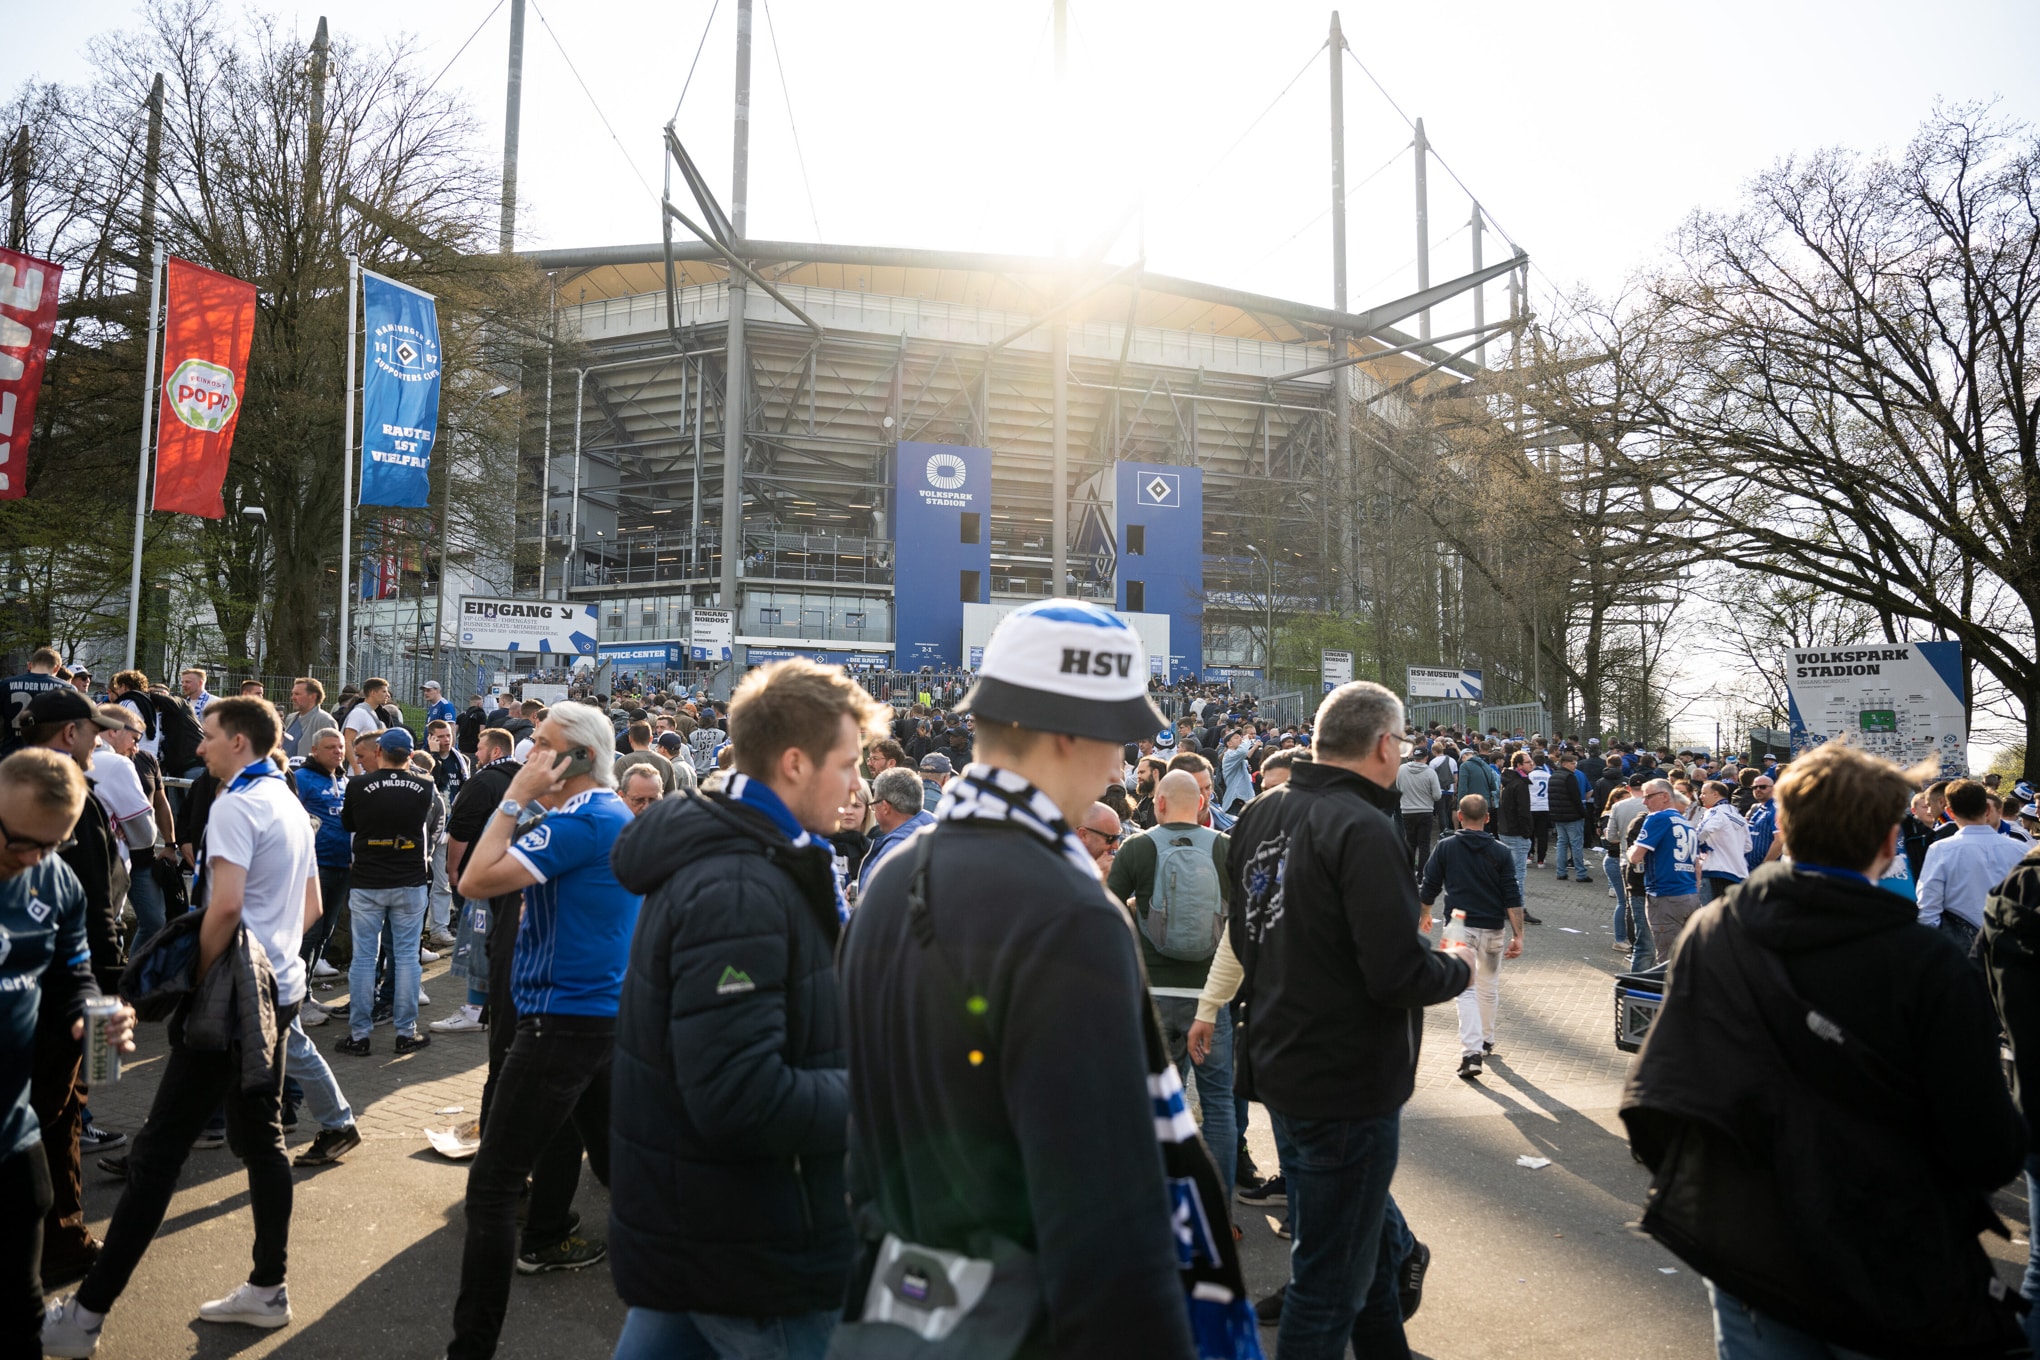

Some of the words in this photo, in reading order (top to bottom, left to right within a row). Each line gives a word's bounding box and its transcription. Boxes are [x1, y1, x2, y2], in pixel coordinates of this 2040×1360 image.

[375, 342, 388, 353] 18
[425, 354, 438, 364] 87
[190, 375, 226, 389] FEINKOST
[178, 384, 230, 412] popp
[382, 423, 431, 441] RAUTE
[394, 440, 418, 453] IST
[919, 489, 973, 501] VOLKSPARK
[925, 498, 966, 507] STADION
[464, 602, 552, 618] EINGANG
[1060, 648, 1132, 677] HSV
[1795, 649, 1909, 664] VOLKSPARK
[1411, 669, 1459, 678] HSV-MUSEUM
[1797, 664, 1880, 678] STADION
[9, 681, 24, 690] VAN
[24, 682, 39, 691] DER
[696, 731, 718, 741] JUST
[363, 781, 380, 794] TSV
[382, 779, 424, 794] MILDSTEDT
[1537, 781, 1547, 797] 2
[1672, 825, 1697, 863] 30
